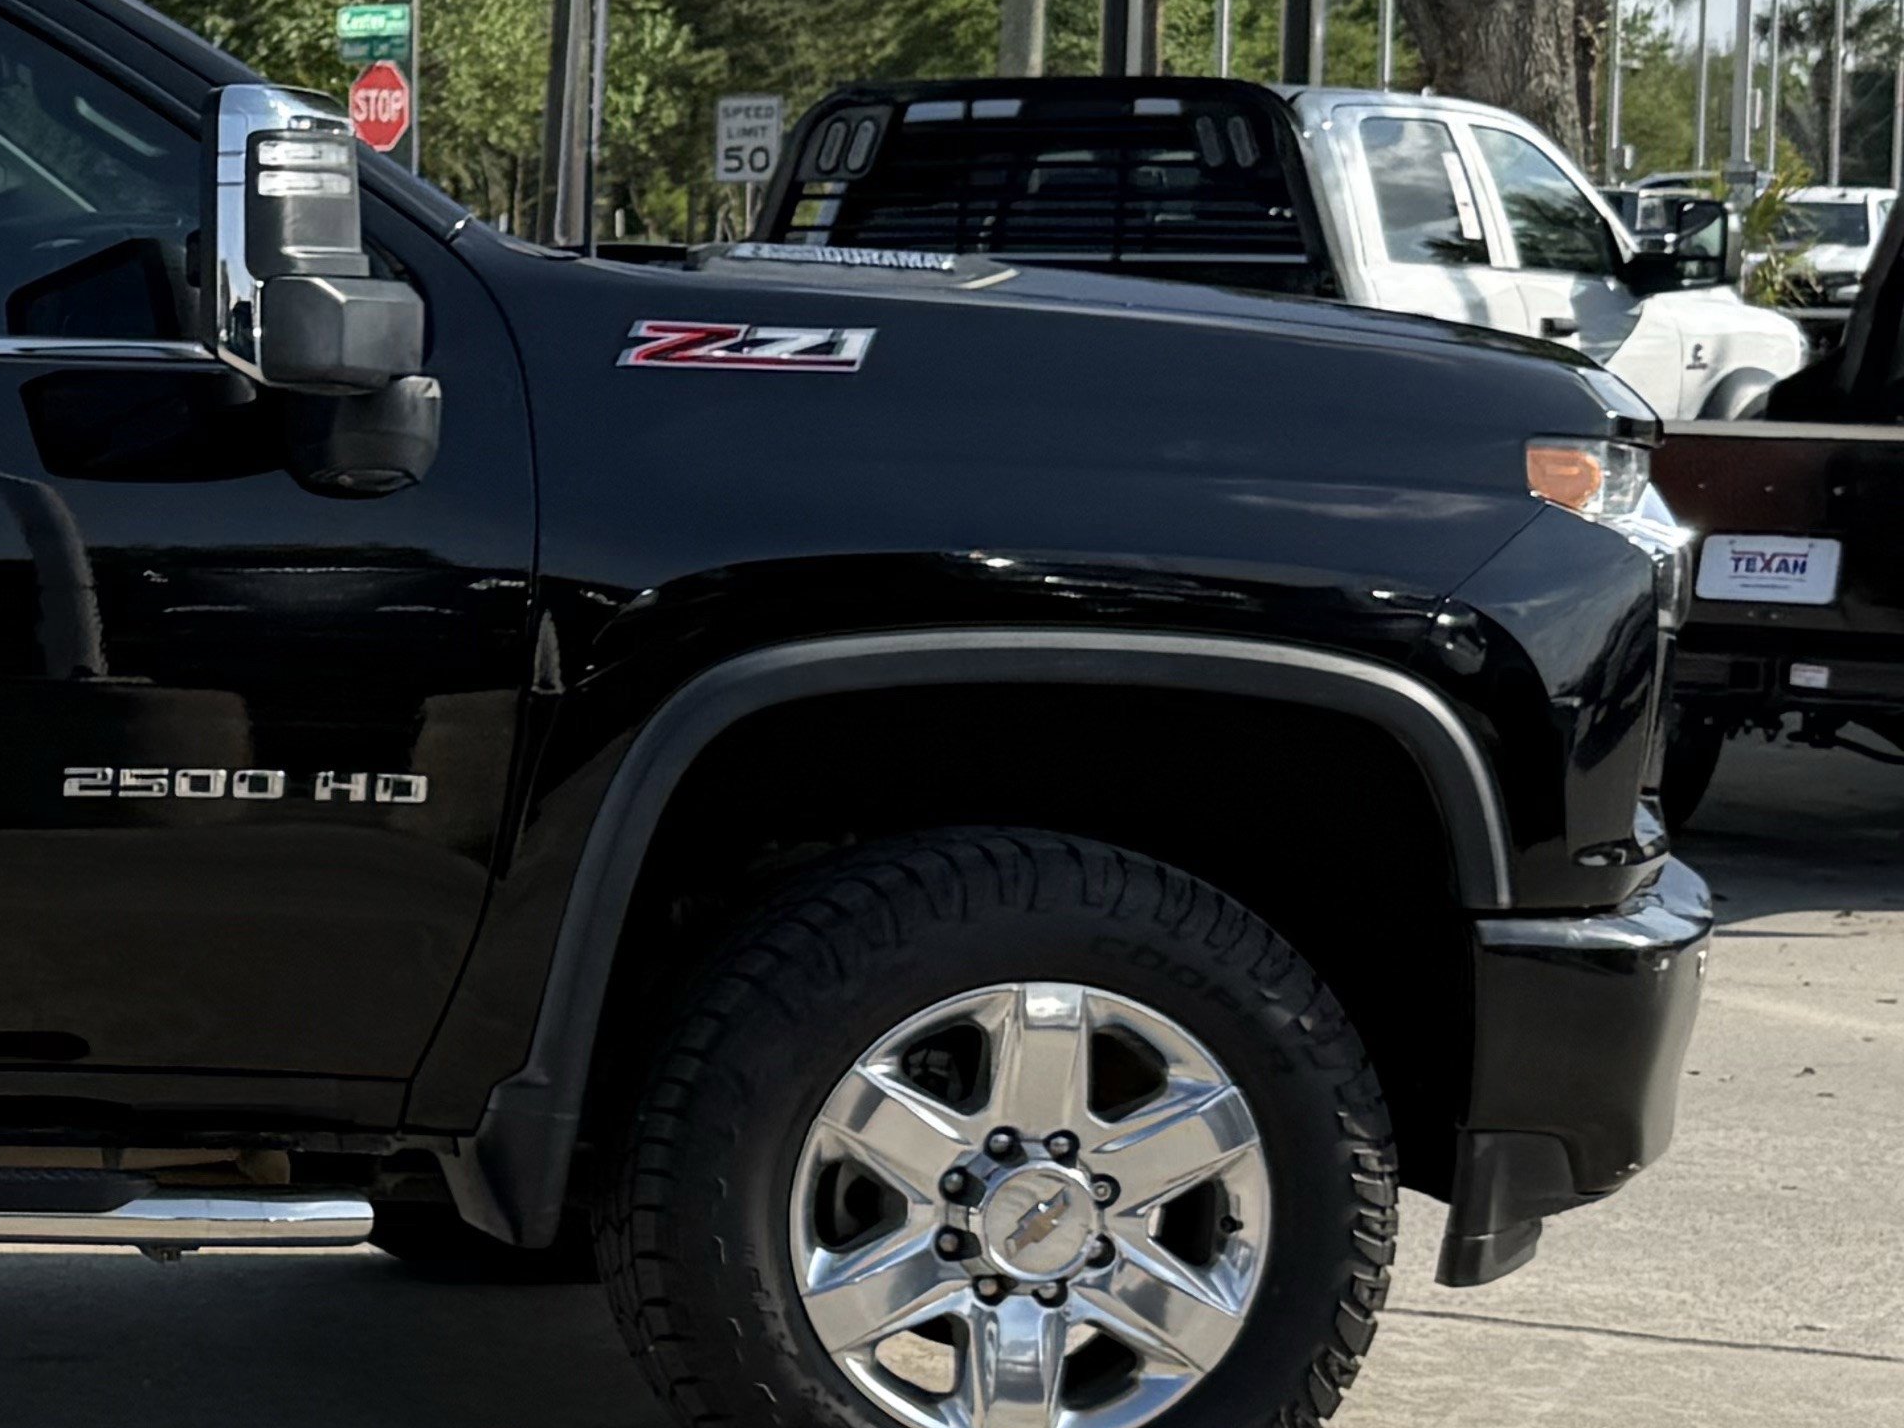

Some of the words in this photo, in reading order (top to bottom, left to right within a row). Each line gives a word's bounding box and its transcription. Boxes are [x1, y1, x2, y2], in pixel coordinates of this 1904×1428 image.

[353, 88, 403, 122] STOP
[722, 104, 775, 119] SPEED
[726, 124, 769, 139] LIMIT
[723, 146, 771, 173] 50
[617, 320, 877, 372] Z71
[1730, 551, 1809, 575] TEXAN
[63, 767, 285, 800] 2500
[314, 770, 428, 804] HD
